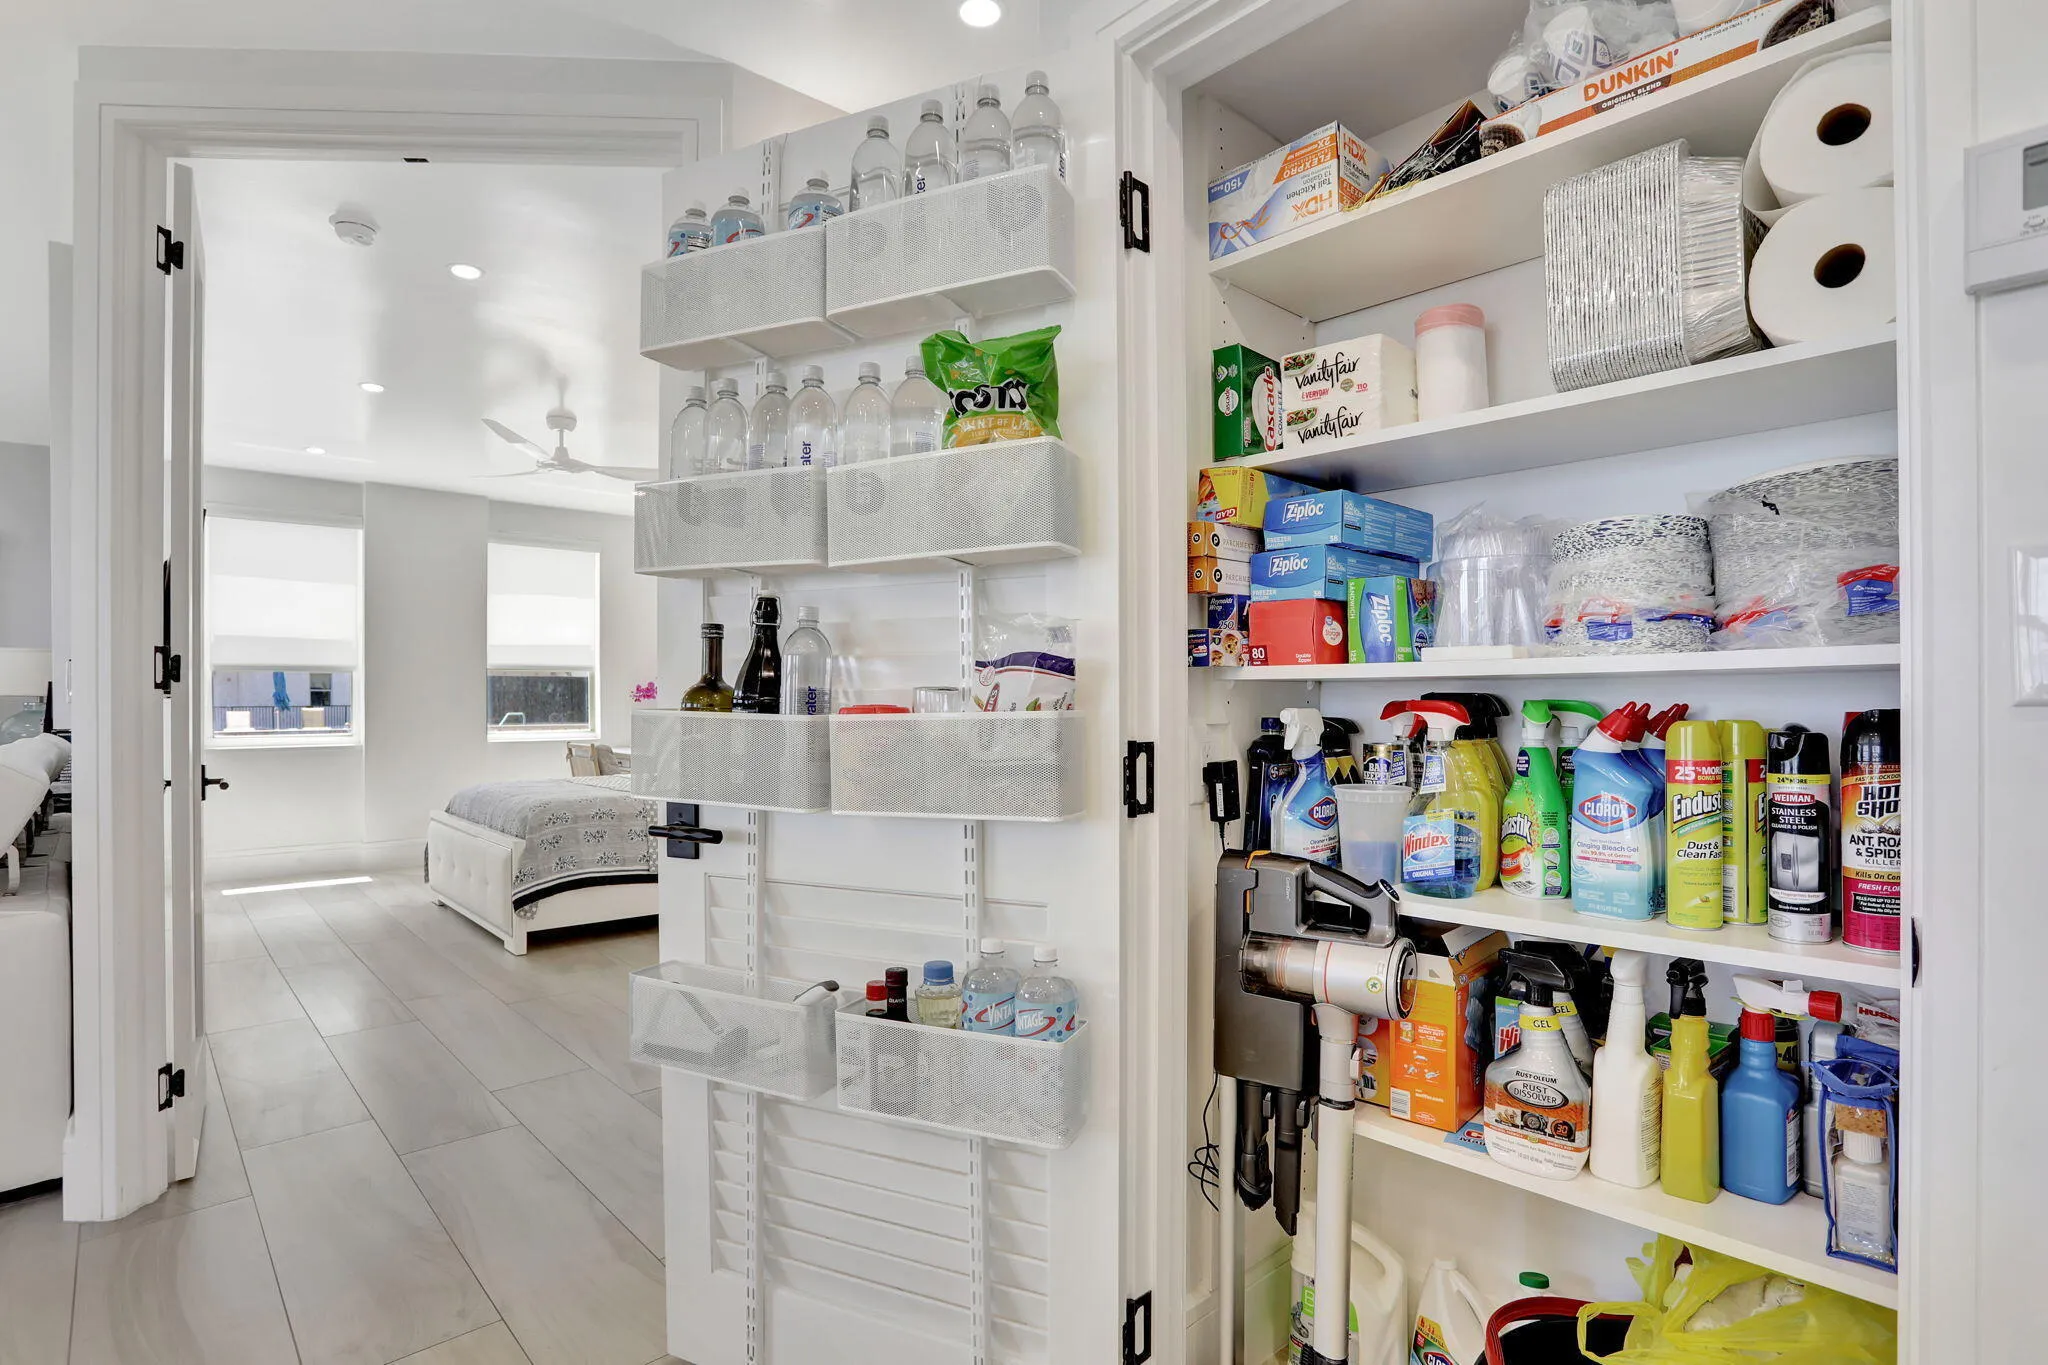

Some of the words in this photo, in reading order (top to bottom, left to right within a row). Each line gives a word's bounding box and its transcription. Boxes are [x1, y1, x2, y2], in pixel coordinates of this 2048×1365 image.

[1583, 48, 1679, 102] DUNKIN'
[1601, 91, 1637, 109] ORIGINAL
[1637, 81, 1662, 96] BLEND
[1342, 132, 1367, 166] HDX
[915, 177, 926, 194] ter
[1224, 177, 1243, 193] 150
[1319, 177, 1332, 189] Tall
[1286, 184, 1317, 200] Kitchen
[1291, 189, 1333, 223] HDX
[1356, 382, 1368, 390] 110
[1301, 387, 1330, 400] EVERYDAY
[1263, 365, 1276, 452] Cascade
[801, 441, 812, 466] ater
[1216, 508, 1236, 520] GLAD
[1286, 501, 1324, 522] Ziploc
[1223, 538, 1254, 550] PARCHMENT
[1271, 557, 1309, 576] Ziploc
[1225, 573, 1250, 583] PARCHME
[1210, 597, 1234, 605] Reynolds
[1209, 604, 1223, 612] Wrap
[1218, 620, 1235, 630] 250
[1370, 593, 1393, 644] Ziploc
[1252, 647, 1265, 659] 80
[1368, 762, 1388, 772] BAR
[1773, 793, 1812, 802] WEIMAN
[1862, 784, 1901, 801] HOT
[1313, 803, 1336, 819] CLORO
[1584, 801, 1628, 819] CLOROX
[1673, 790, 1721, 823] Endust
[1771, 807, 1817, 817] STAINLESS
[1857, 799, 1901, 819] SHO
[1778, 815, 1807, 825] STEEL
[1404, 831, 1451, 861] Windex
[1576, 841, 1601, 851] Clinging
[1601, 843, 1626, 852] Bleach
[1687, 841, 1712, 850] Dust
[1713, 841, 1719, 850] &
[1877, 836, 1901, 848] ROA
[1676, 849, 1707, 859] Clean
[1708, 850, 1722, 859] Fas
[1855, 848, 1863, 857] &
[1865, 846, 1901, 859] SPIDE
[1411, 869, 1435, 878] ORIGINAL
[1855, 871, 1872, 879] Kills
[1886, 873, 1901, 881] Con
[1857, 882, 1881, 891] FRESH
[1882, 884, 1901, 892] FLO
[988, 1001, 1014, 1025] VINTA
[1554, 1005, 1571, 1014] GEL
[1016, 1008, 1045, 1032] NTAGE
[1533, 1019, 1552, 1028] GEL
[1498, 1026, 1520, 1053] Wi
[1522, 1082, 1549, 1095] RUST
[1513, 1087, 1557, 1105] DISSOLVER
[1556, 1124, 1568, 1135] 30
